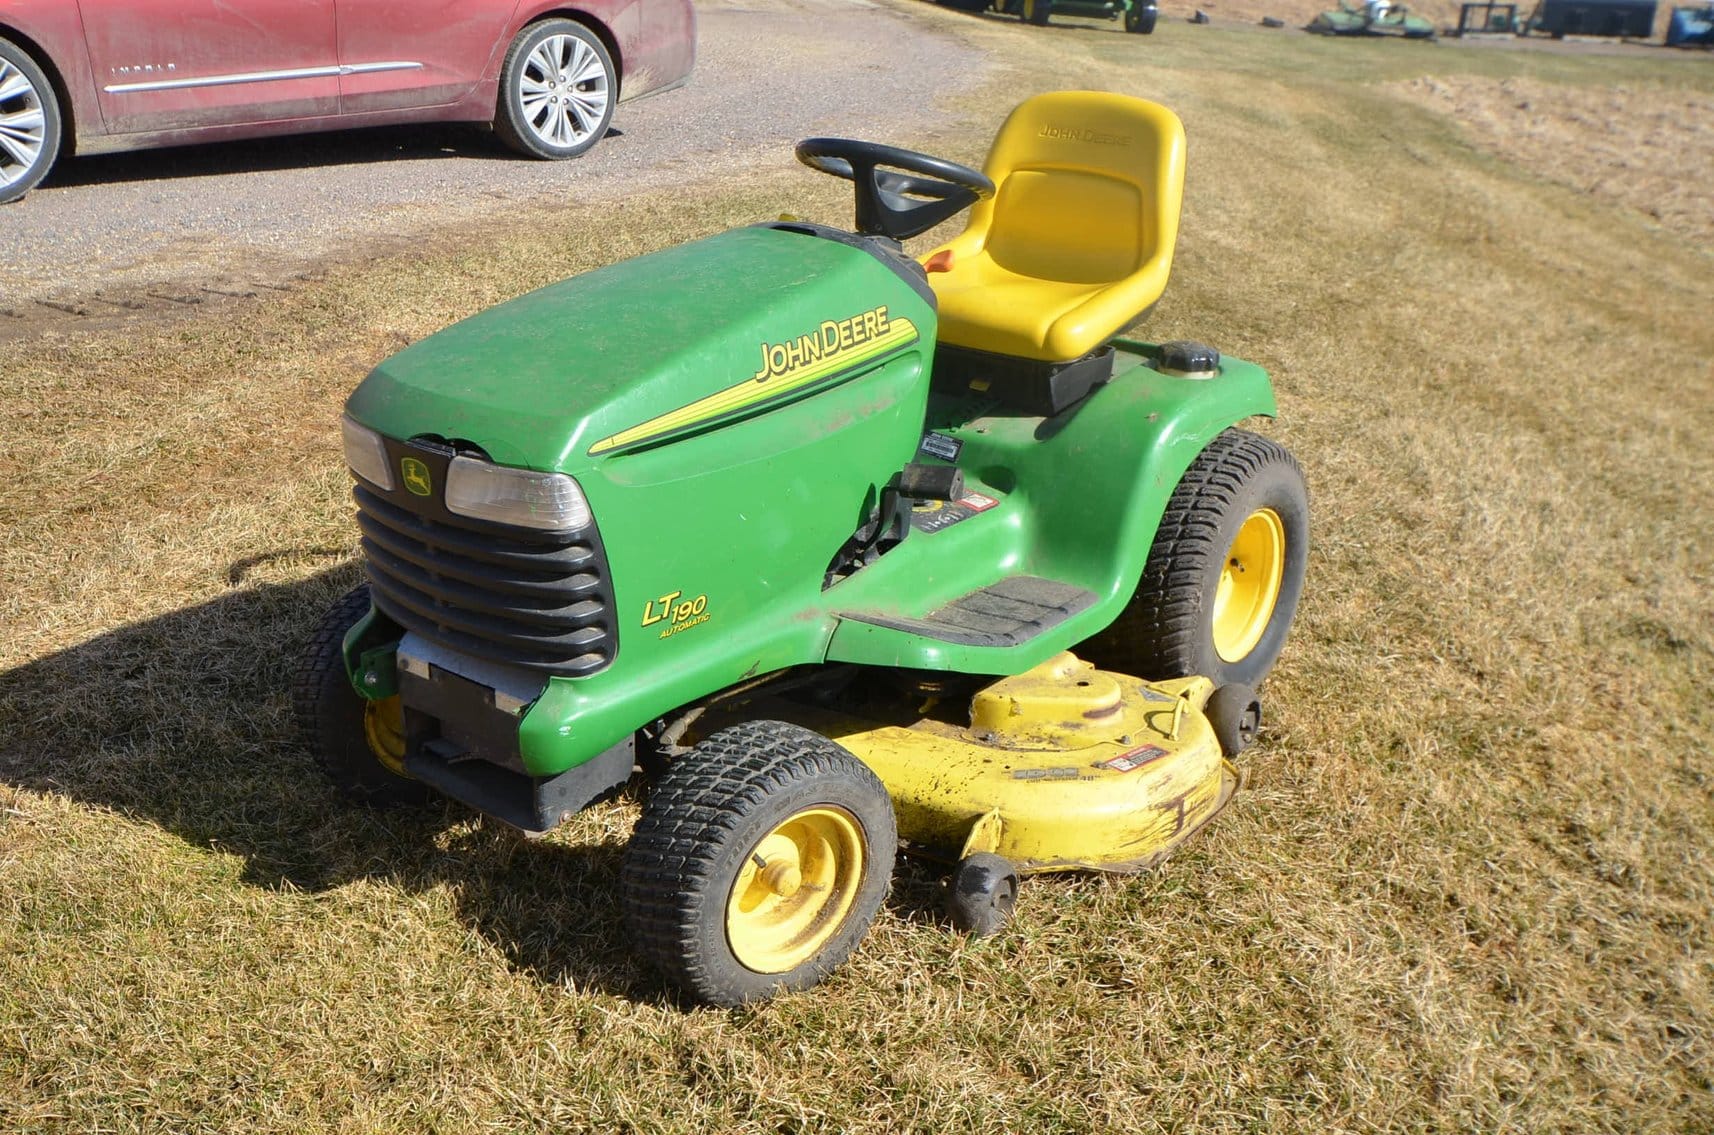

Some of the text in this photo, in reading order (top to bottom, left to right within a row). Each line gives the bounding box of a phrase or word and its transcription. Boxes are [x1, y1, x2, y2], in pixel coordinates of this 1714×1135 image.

[1038, 124, 1080, 141] JOHN
[755, 305, 891, 383] JOHN DEERE
[641, 590, 708, 627] LT190
[659, 612, 711, 640] AUTOMATIC
